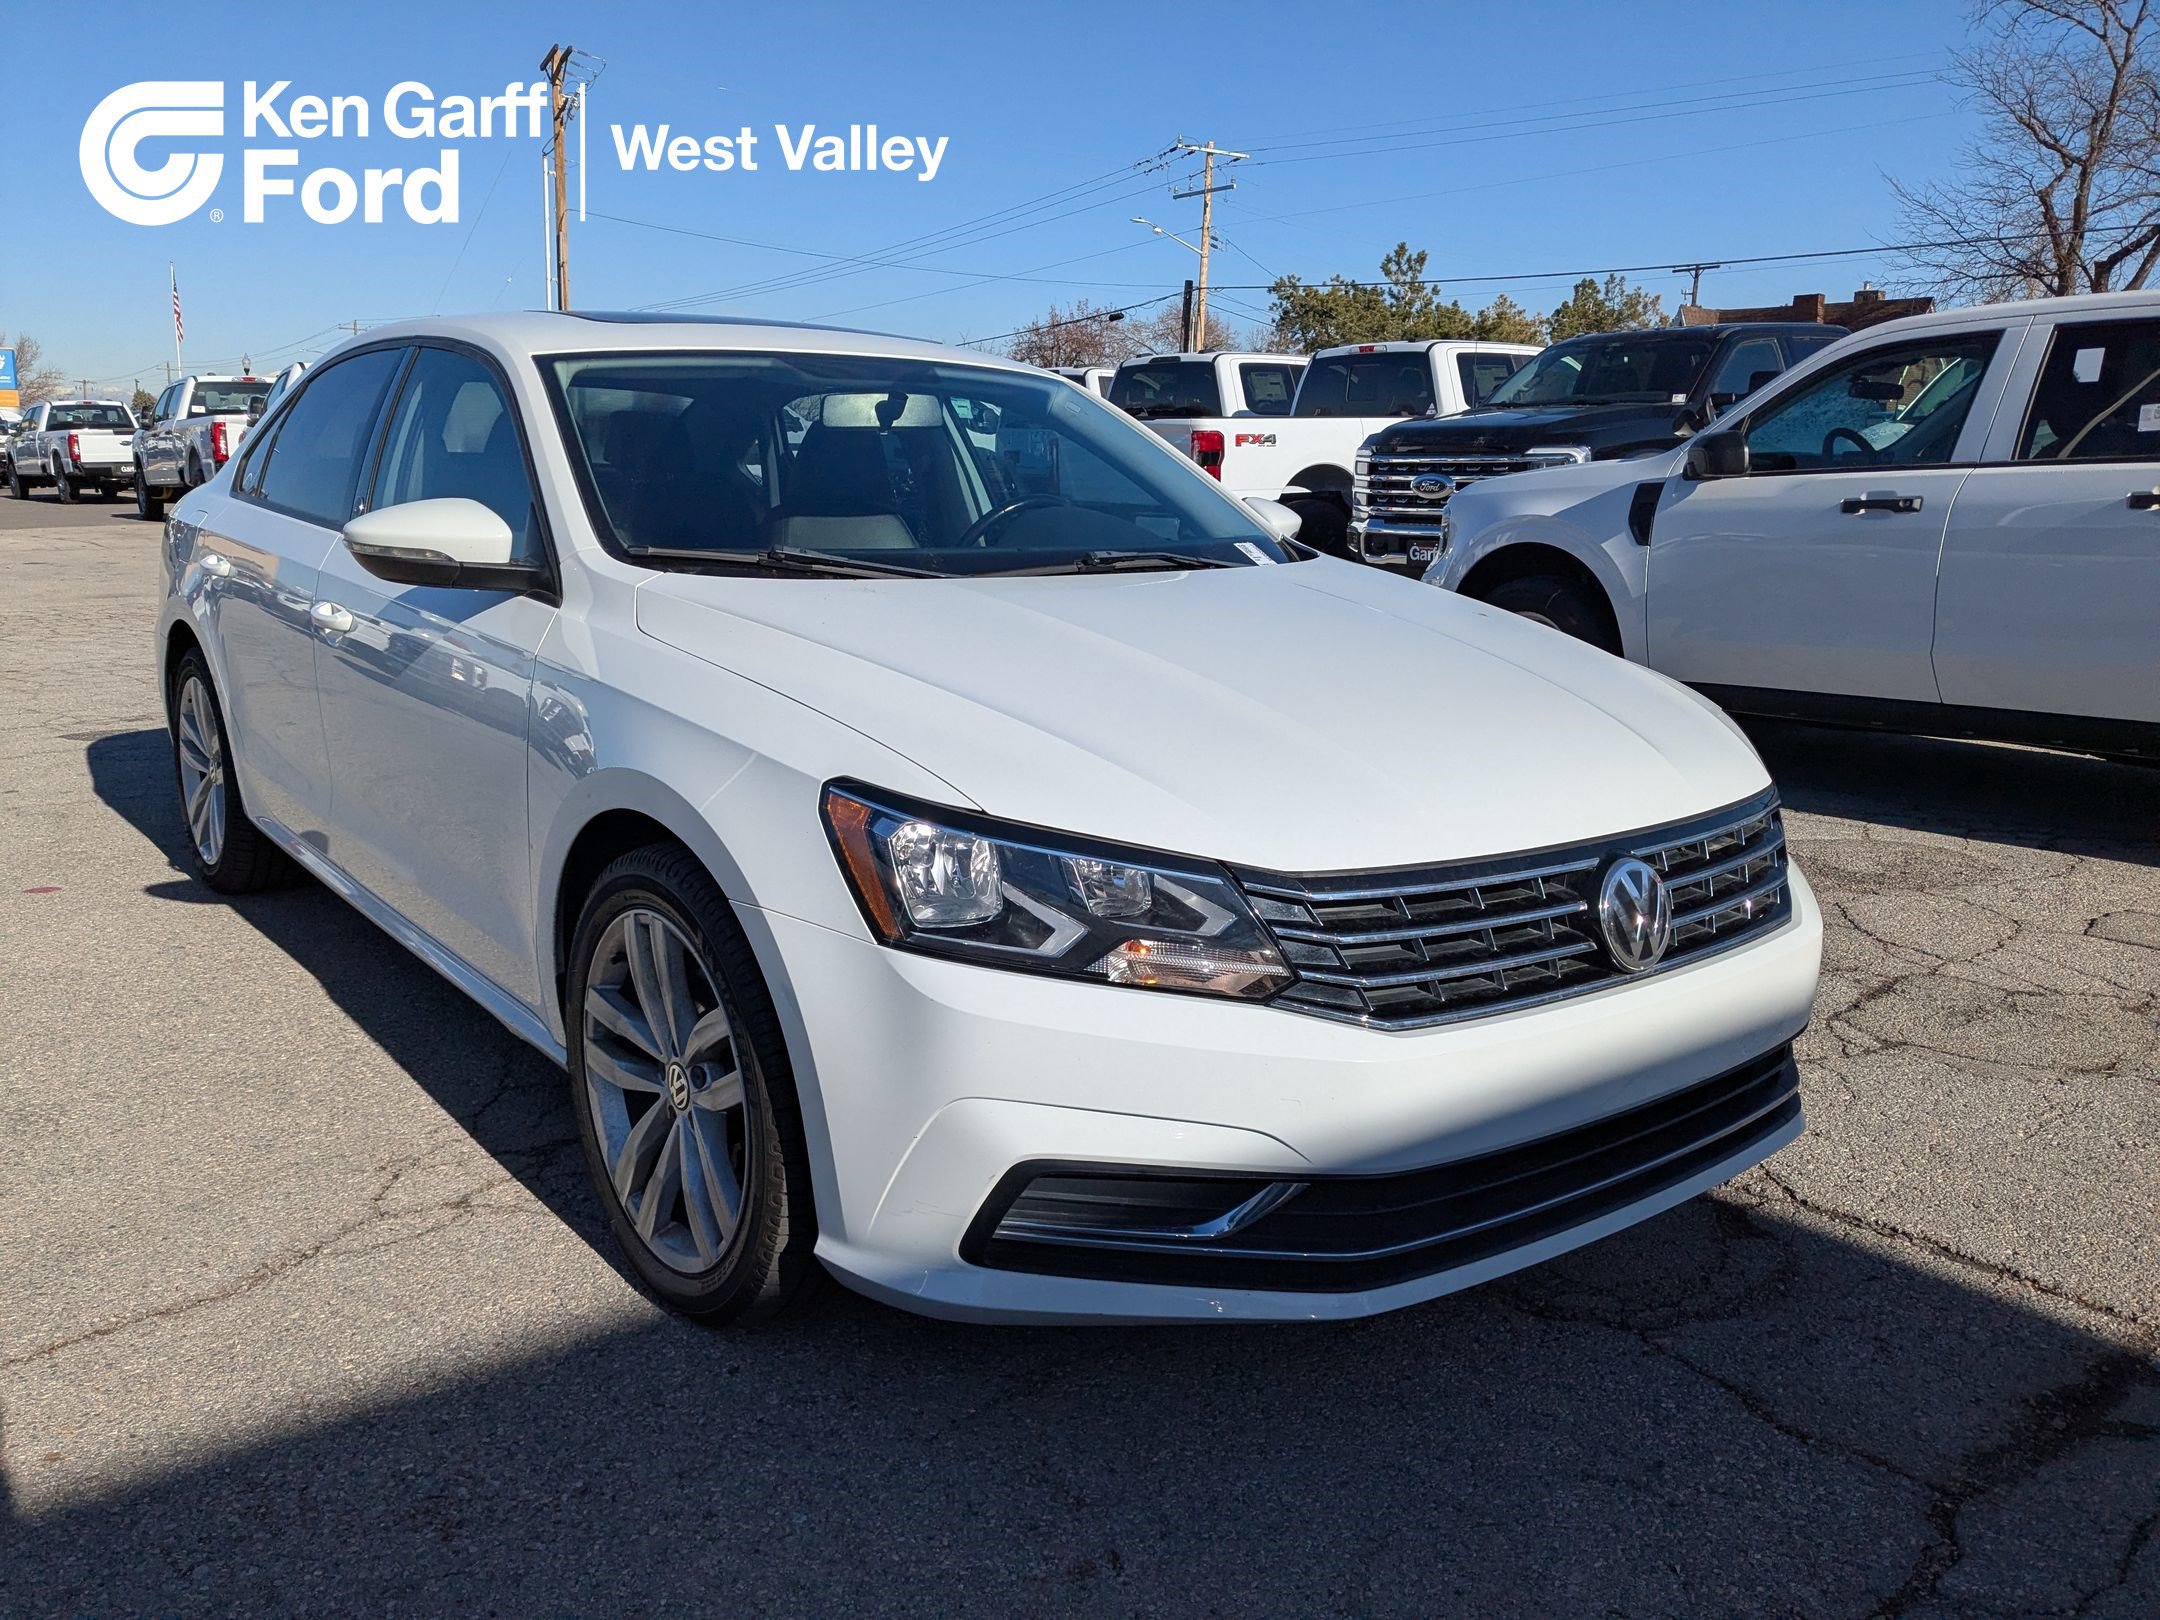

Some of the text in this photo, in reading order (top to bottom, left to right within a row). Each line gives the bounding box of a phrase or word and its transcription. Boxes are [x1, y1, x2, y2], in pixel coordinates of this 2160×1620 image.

[1235, 433, 1277, 447] FX4
[1419, 480, 1440, 492] Ford
[1409, 545, 1439, 561] Garf
